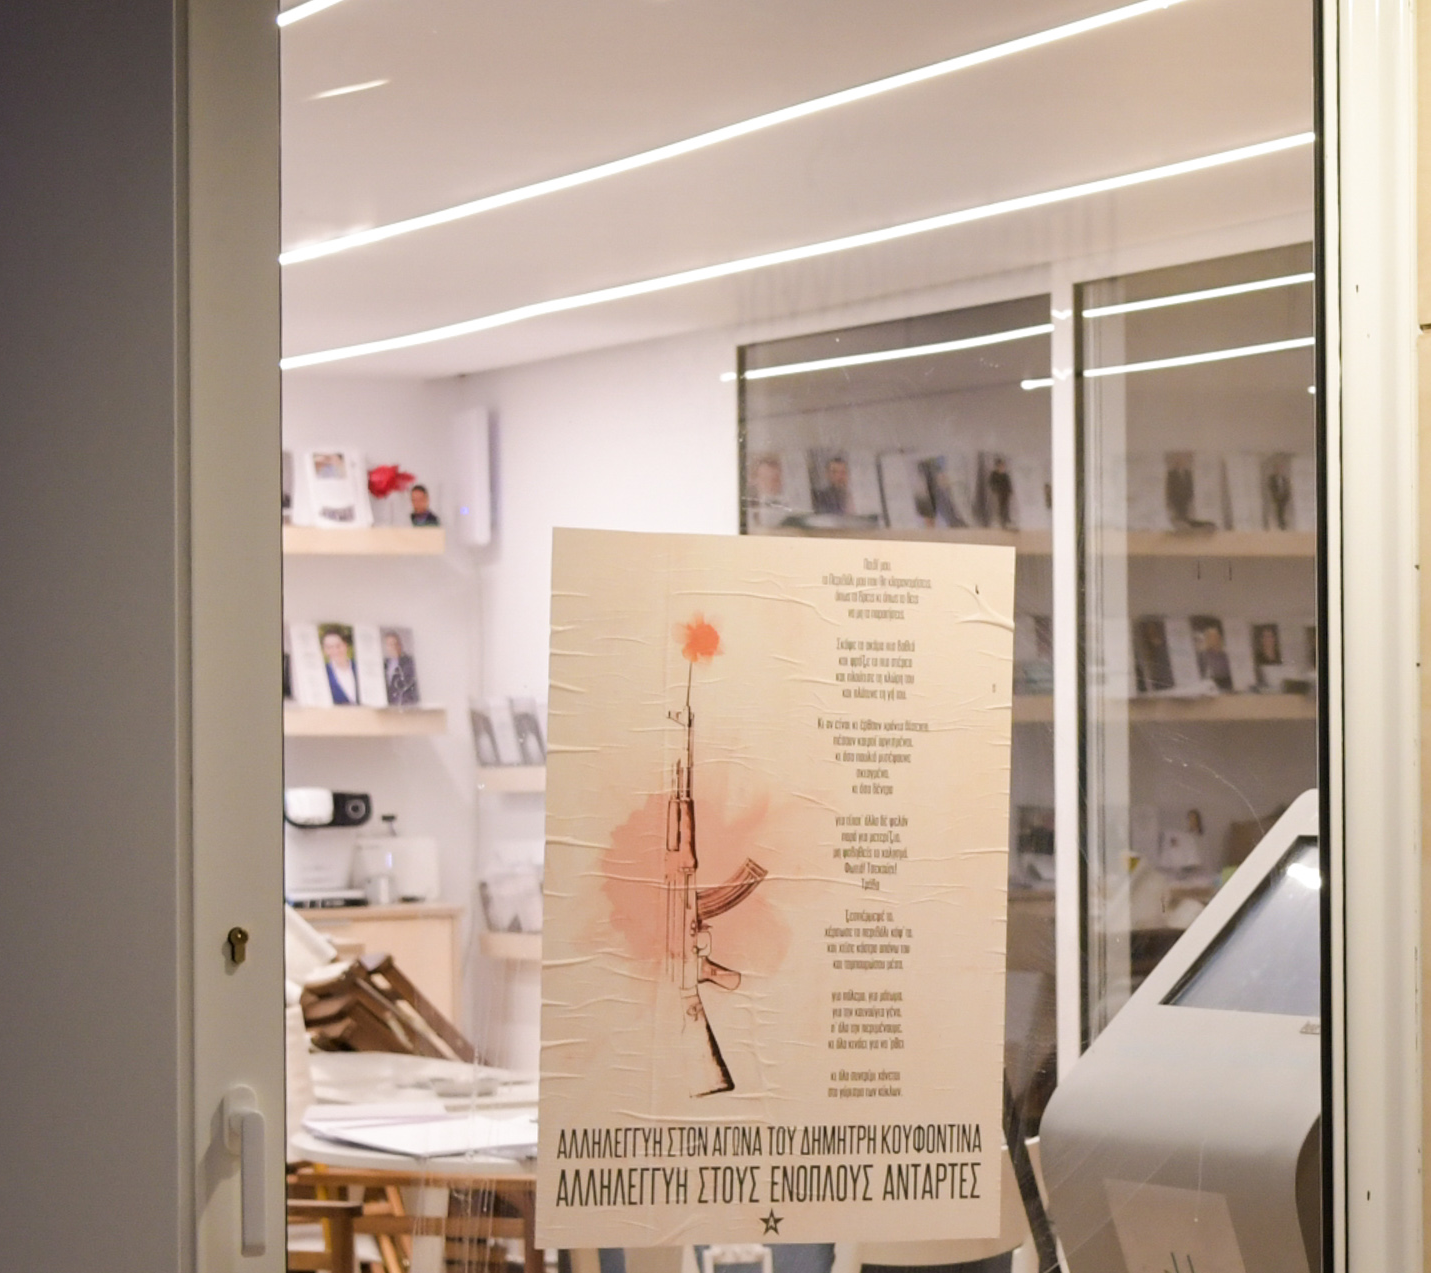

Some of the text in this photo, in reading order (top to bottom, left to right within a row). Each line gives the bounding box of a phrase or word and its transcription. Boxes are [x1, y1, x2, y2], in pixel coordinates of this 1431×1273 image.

[557, 1124, 982, 1159] ΑΛΛΗΛΕΓΓΥΗ ΣΤΟΝ ΑΓΩΝΑ ΤΟΥ ΔΗΜΗΤΡΗ ΚΟΥΦΟΝΤΙΝΑ
[556, 1162, 981, 1207] ΑΛΛΗΛΕΓΓΥΗ ΣΤΟΥΣ ΕΝΟΠΛΟΥΣ ΑΝΤΑΡΤΕΣ
